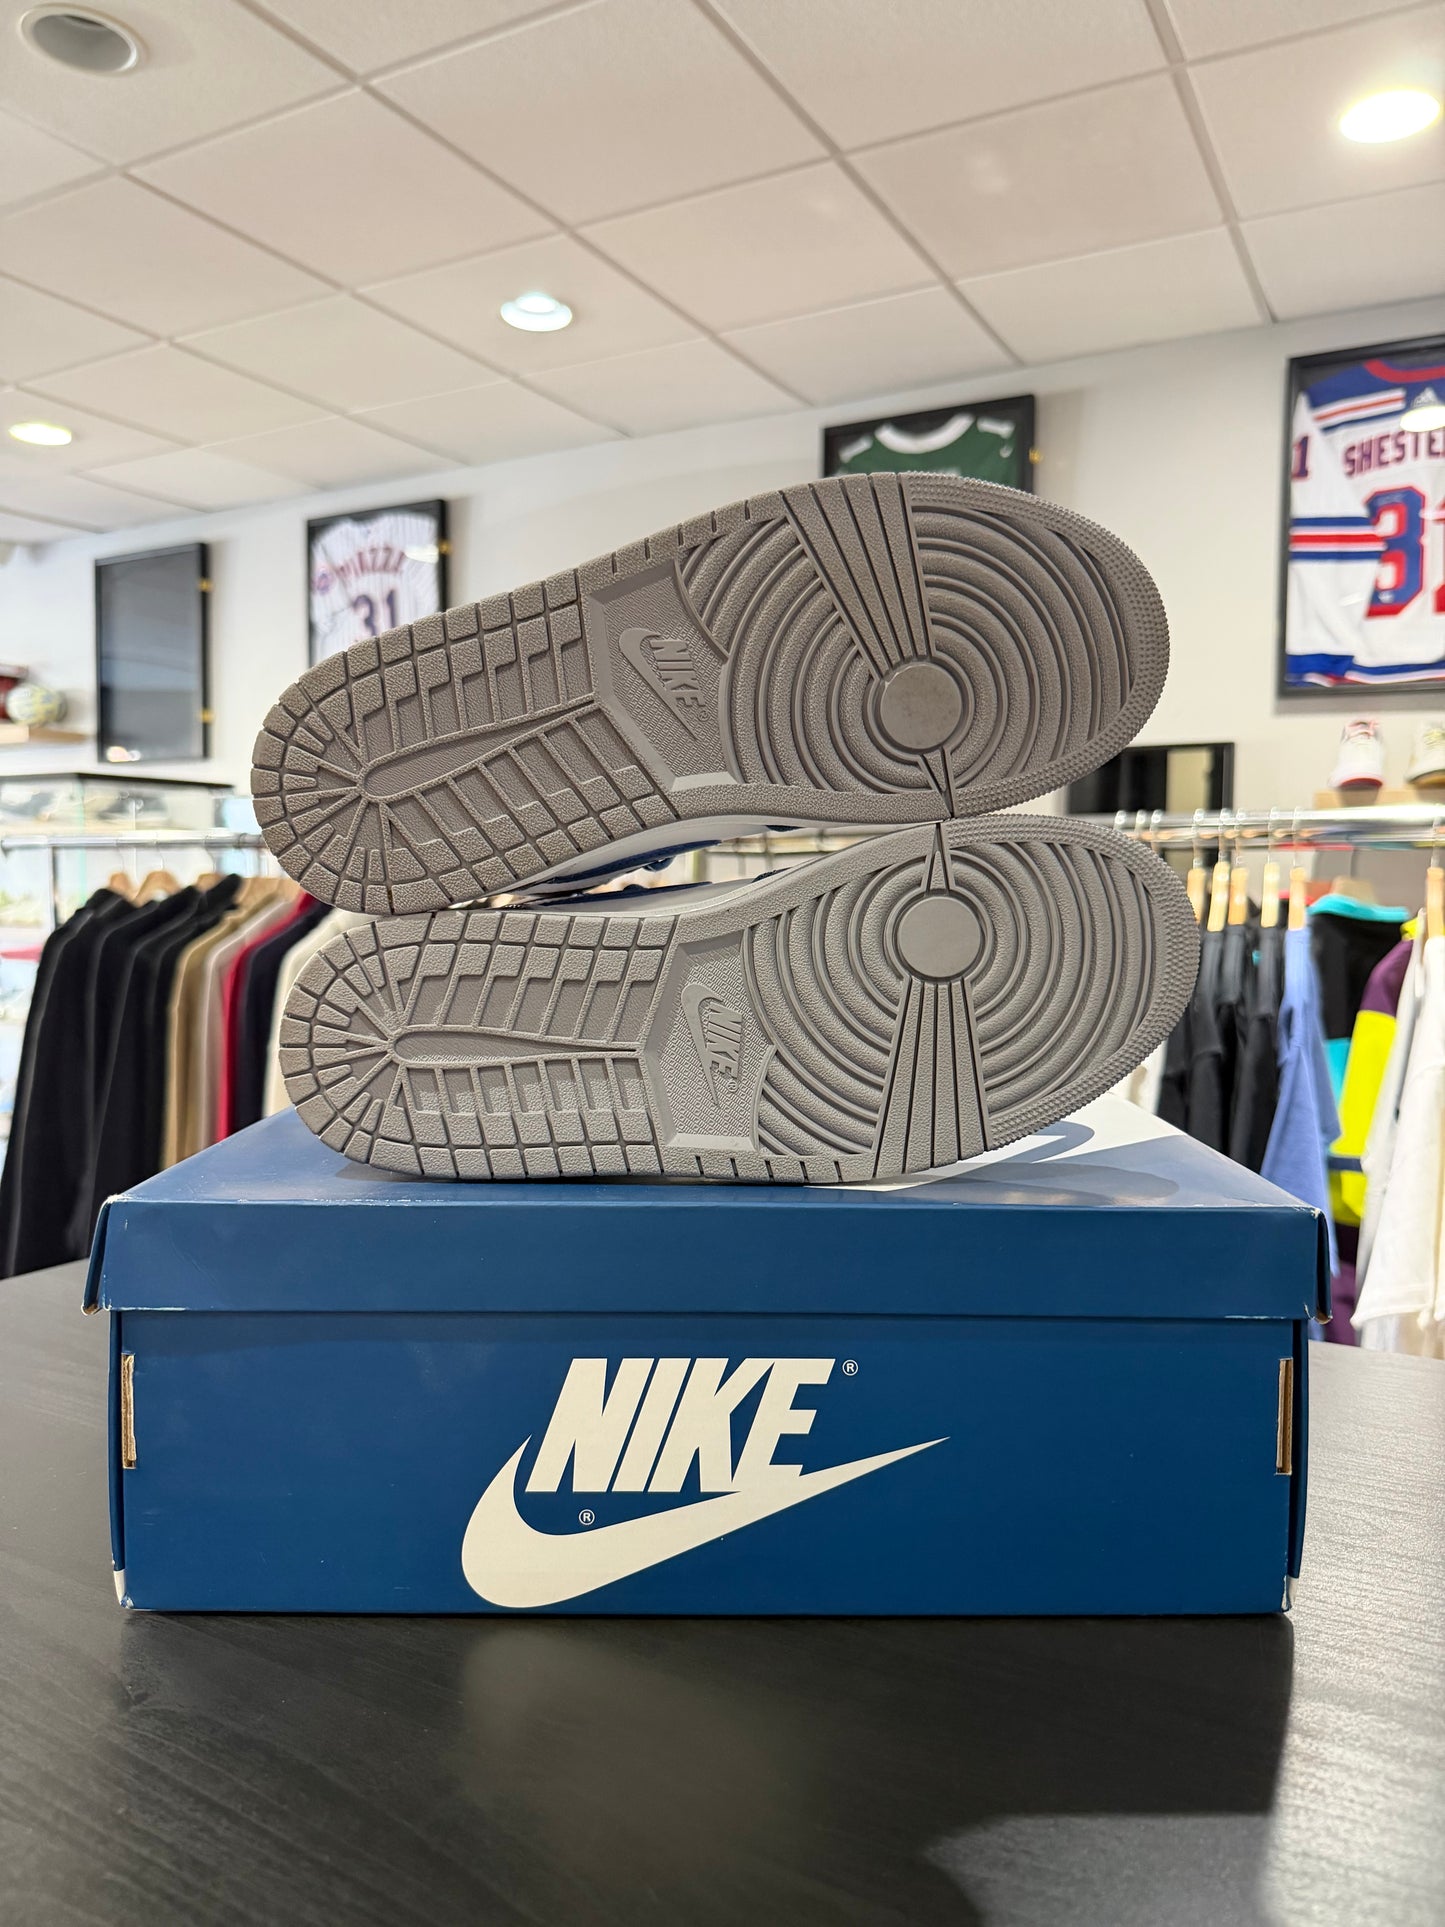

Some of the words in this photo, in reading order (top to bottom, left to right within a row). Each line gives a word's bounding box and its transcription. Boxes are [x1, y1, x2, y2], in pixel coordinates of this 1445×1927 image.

[1343, 429, 1445, 477] SHESTE
[350, 587, 397, 638] 31
[649, 638, 707, 710] NIKE
[706, 1000, 743, 1080] NIKE
[525, 1357, 836, 1493] NIKE
